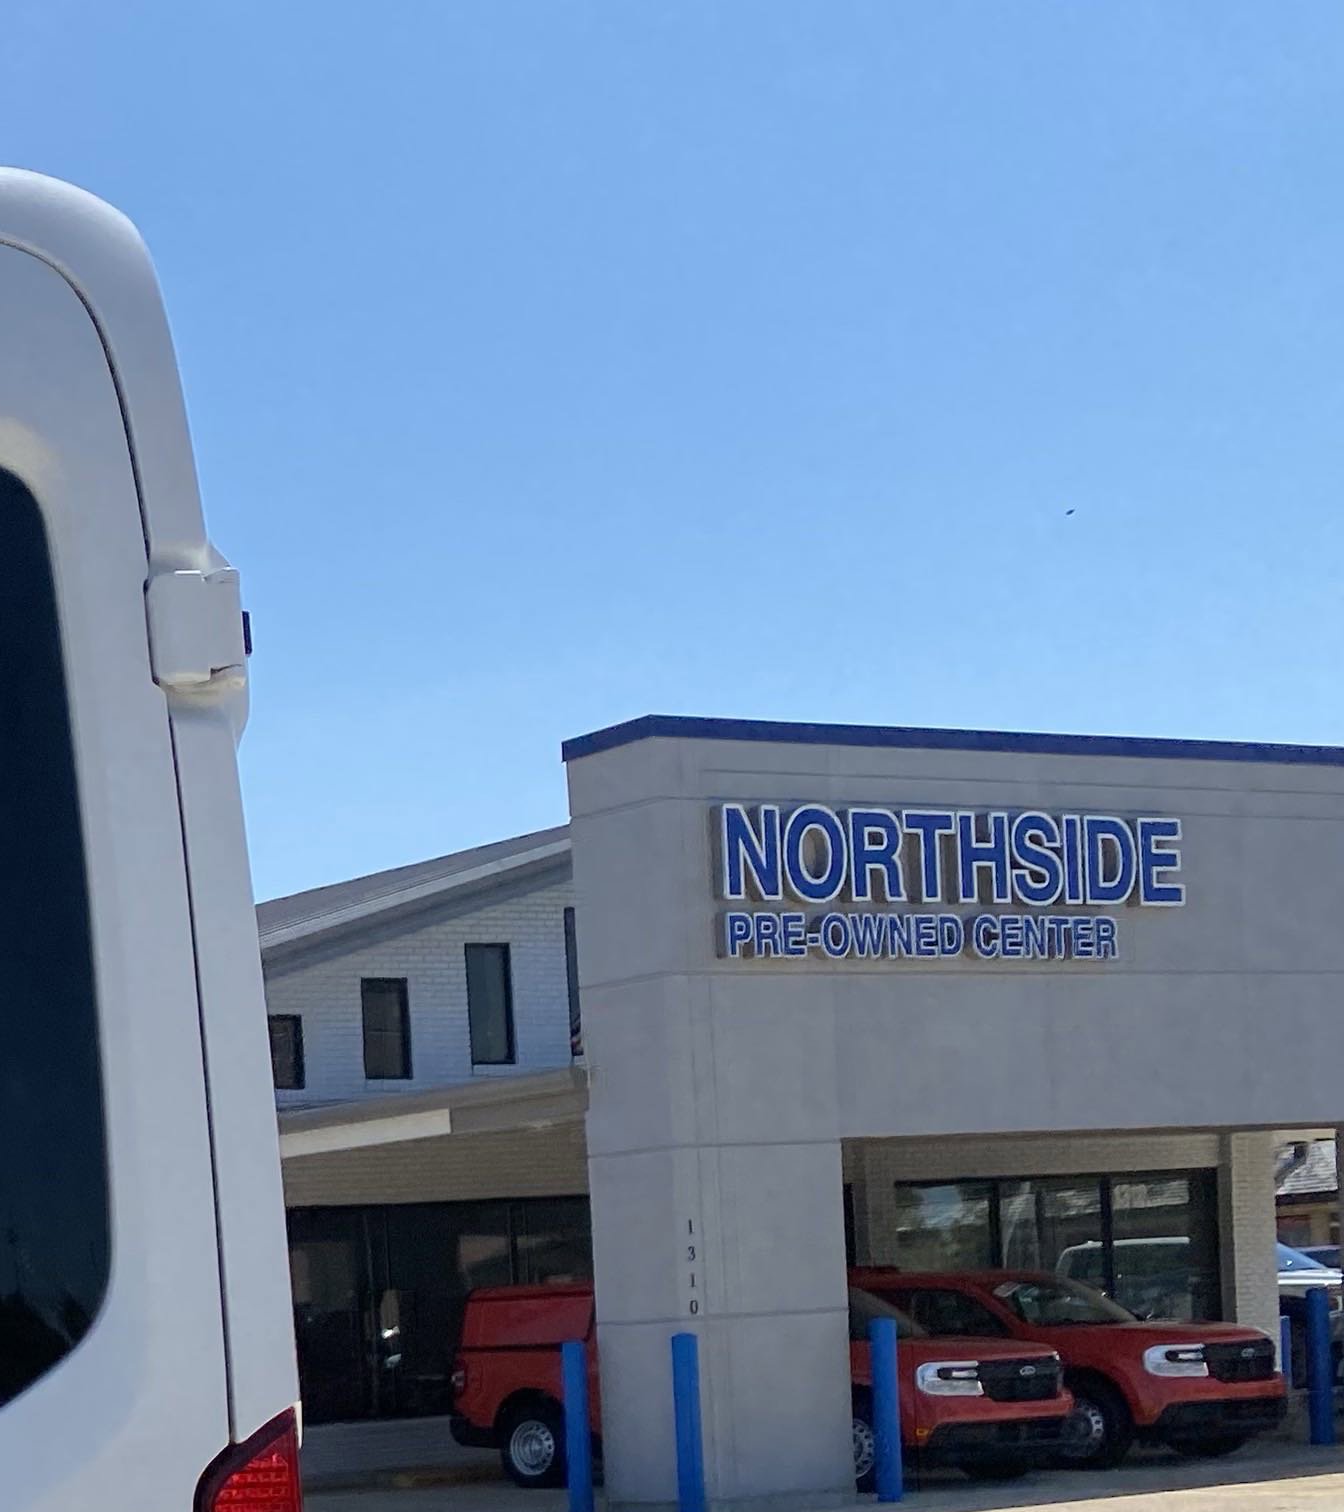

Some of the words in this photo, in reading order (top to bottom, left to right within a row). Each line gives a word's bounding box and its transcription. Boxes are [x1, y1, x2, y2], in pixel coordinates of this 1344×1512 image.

[720, 803, 1186, 906] NORTHSIDE
[727, 911, 964, 959] PRE-OWNED
[972, 915, 1120, 959] CENTER
[686, 1218, 699, 1315] 1310
